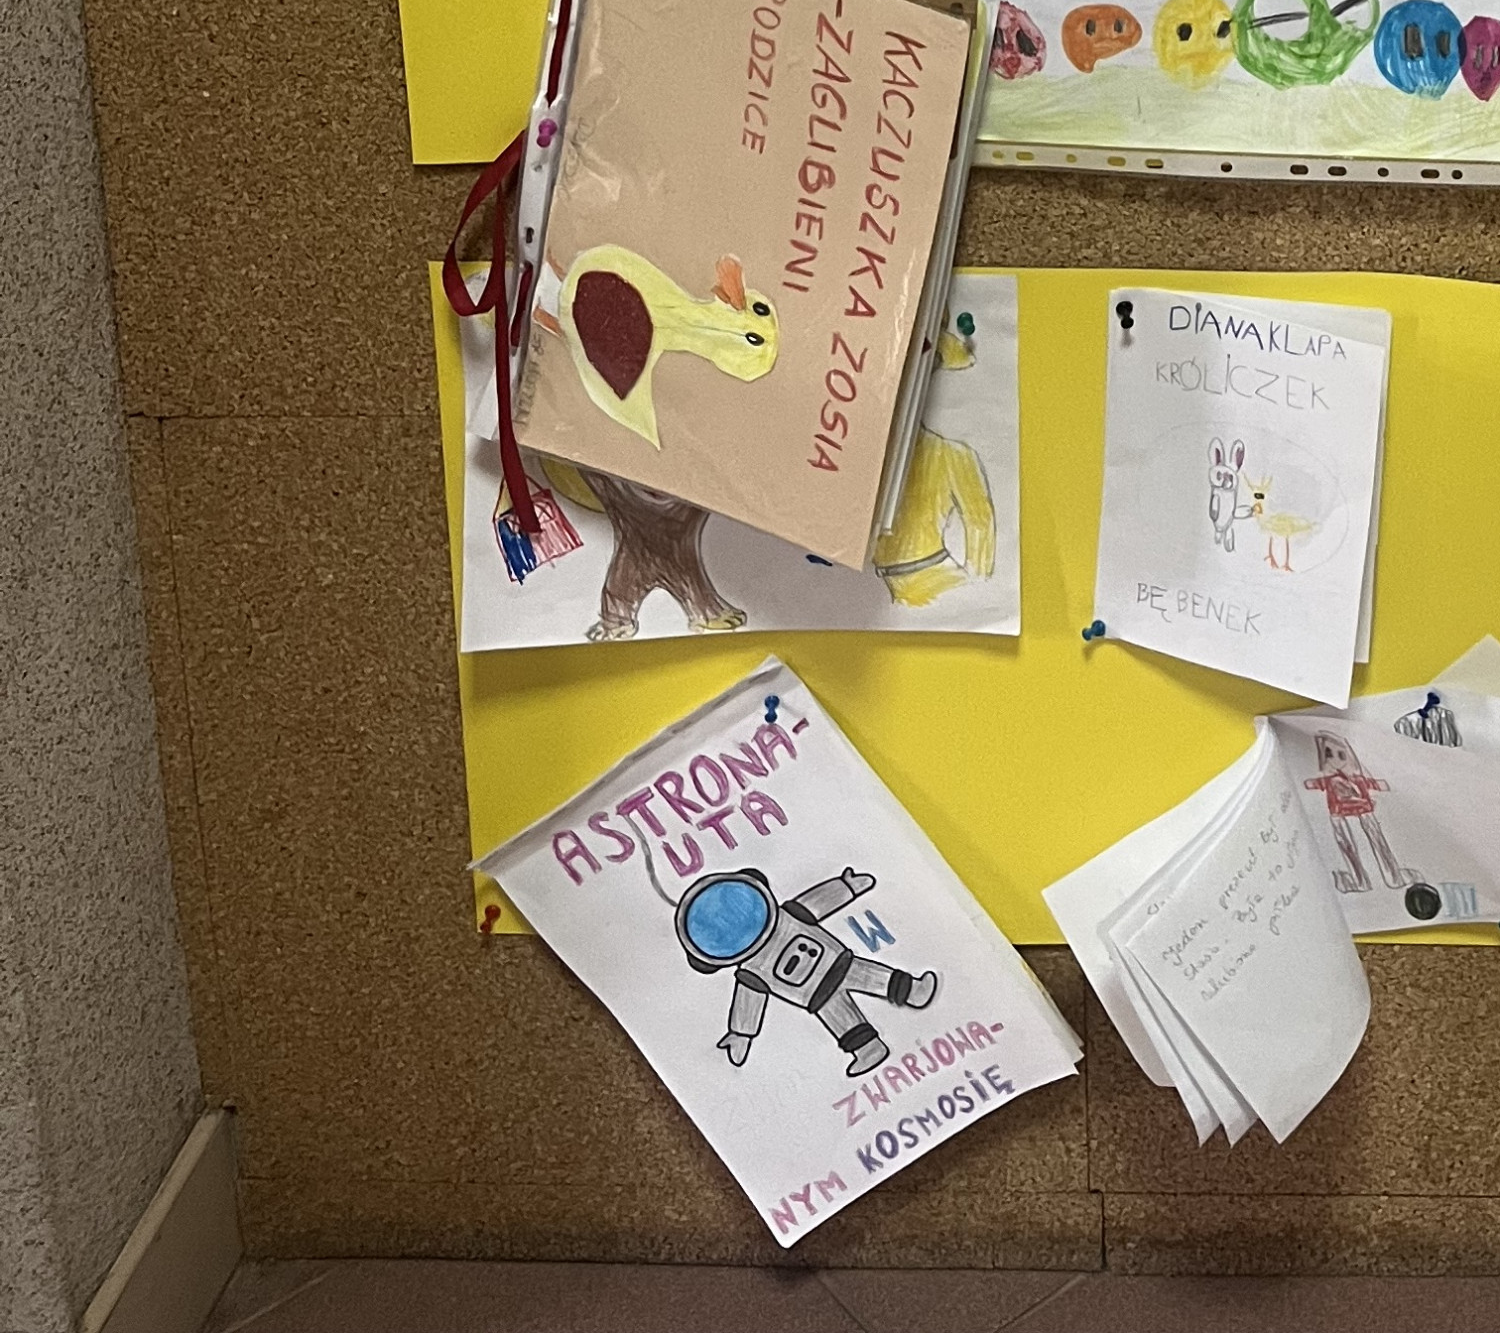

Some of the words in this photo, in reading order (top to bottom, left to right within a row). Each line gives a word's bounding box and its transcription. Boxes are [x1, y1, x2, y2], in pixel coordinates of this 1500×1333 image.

[844, 31, 928, 319] KACZUSZKA
[807, 332, 868, 474] ZOSIA
[1155, 354, 1329, 410] KRÓLICZEK
[550, 718, 810, 886] ASTRONA-
[662, 791, 789, 877] UTA
[848, 909, 896, 953] W
[766, 1171, 848, 1235] NYM
